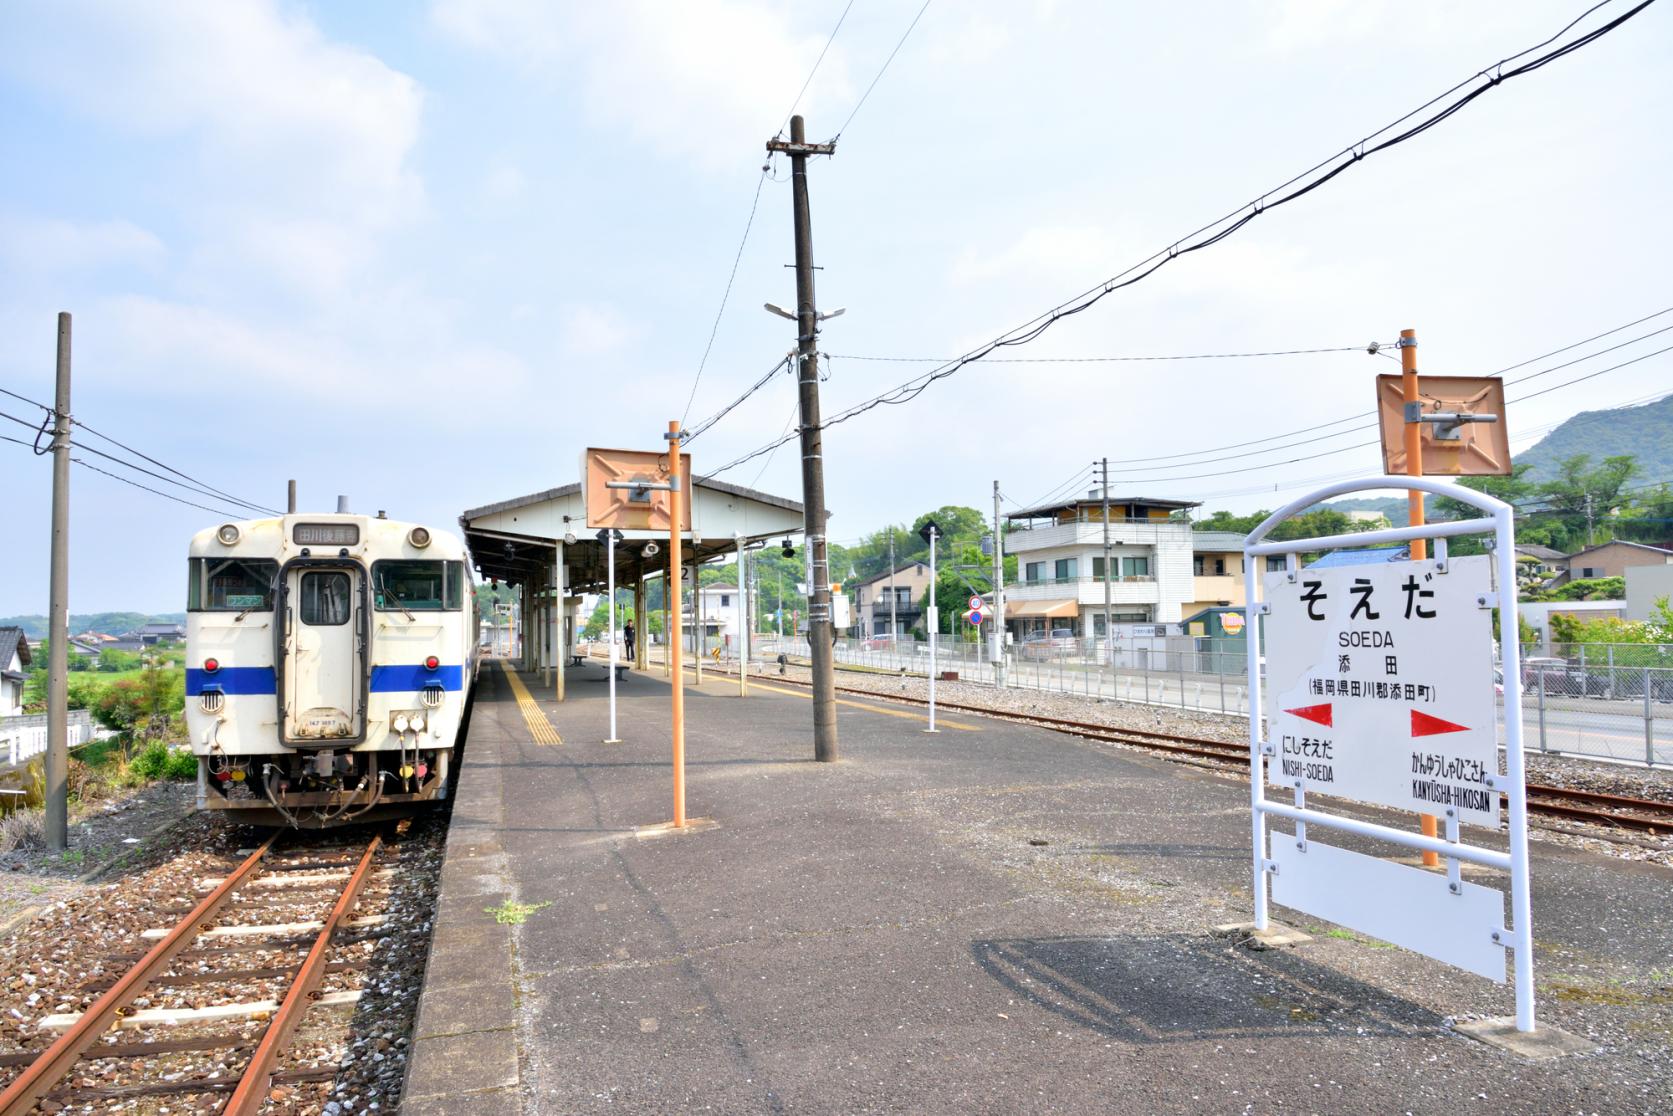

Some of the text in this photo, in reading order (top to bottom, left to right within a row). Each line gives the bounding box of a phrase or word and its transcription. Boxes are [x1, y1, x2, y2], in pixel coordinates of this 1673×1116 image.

[681, 567, 689, 580] 2
[1300, 573, 1437, 620] そえだ
[1339, 631, 1394, 648] SOEDA
[1339, 655, 1398, 675] 添田
[1309, 678, 1436, 702] (福岡県田川郡添田町)
[1282, 735, 1333, 760] にしそえだ
[1282, 759, 1334, 783] NISHI-SOEDA
[1411, 752, 1486, 784] かんゆうしゃひこさん
